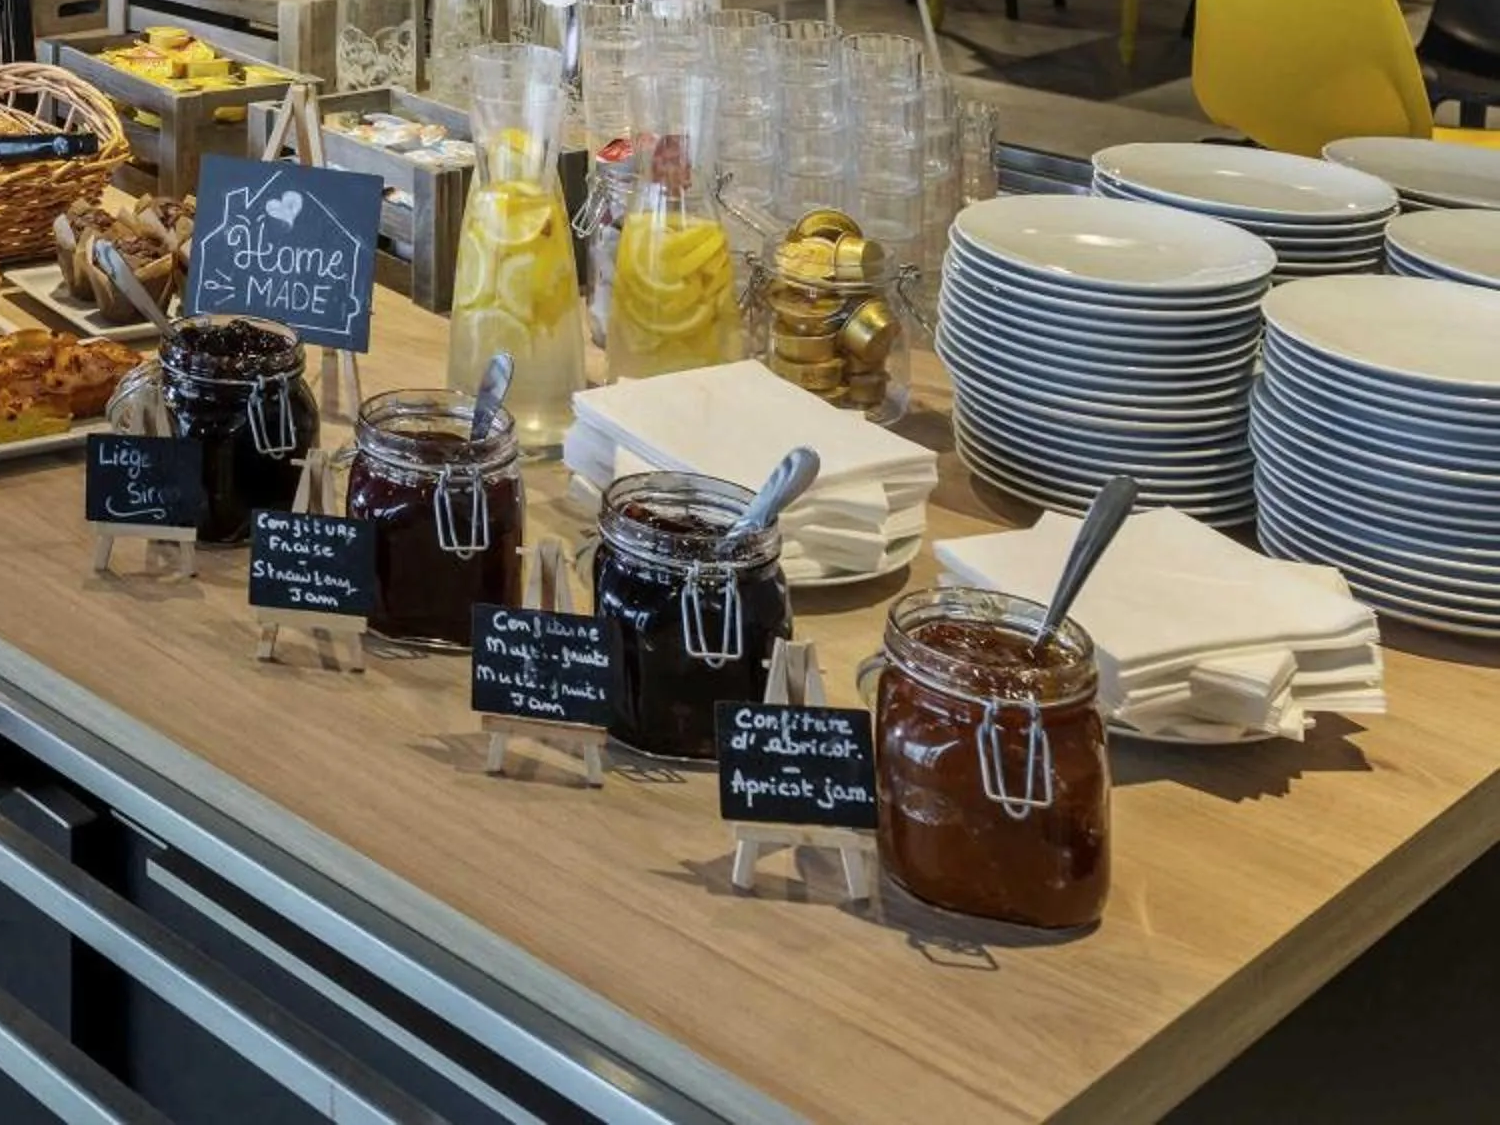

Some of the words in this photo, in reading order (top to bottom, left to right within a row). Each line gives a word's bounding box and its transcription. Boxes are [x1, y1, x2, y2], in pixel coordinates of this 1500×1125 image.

[227, 219, 347, 280] Home
[246, 275, 332, 315] MADE
[269, 535, 334, 557] Fraise
[288, 587, 339, 607] Jam
[510, 691, 565, 716] Jam
[735, 708, 853, 736] Confiture
[731, 768, 814, 808] Apricot
